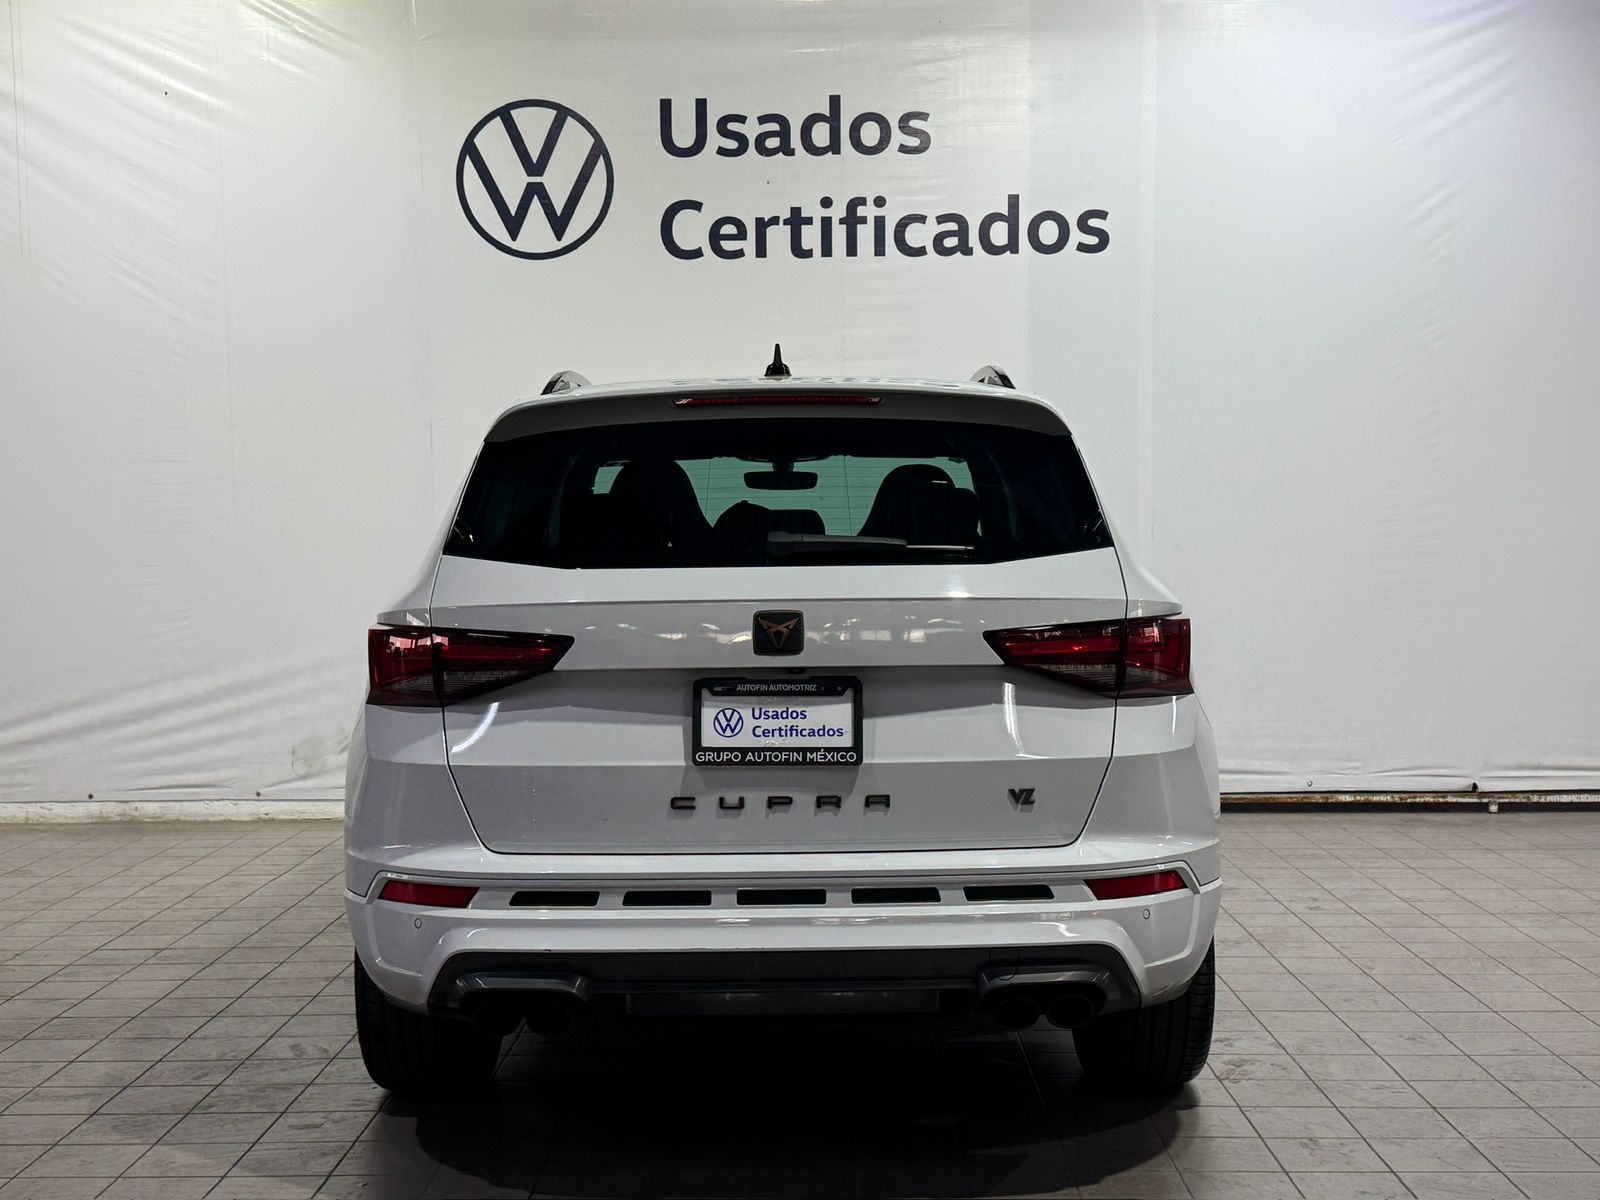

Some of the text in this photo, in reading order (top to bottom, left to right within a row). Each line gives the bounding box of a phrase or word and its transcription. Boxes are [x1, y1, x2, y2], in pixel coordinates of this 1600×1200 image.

[659, 95, 931, 158] Usados
[660, 194, 1110, 260] Certificados
[751, 707, 807, 720] Usados
[752, 725, 844, 738] Certificados
[696, 749, 857, 762] GRUPO AUTOFIN MÉXICO
[670, 794, 891, 810] CUPRA
[1008, 788, 1035, 804] VZ
